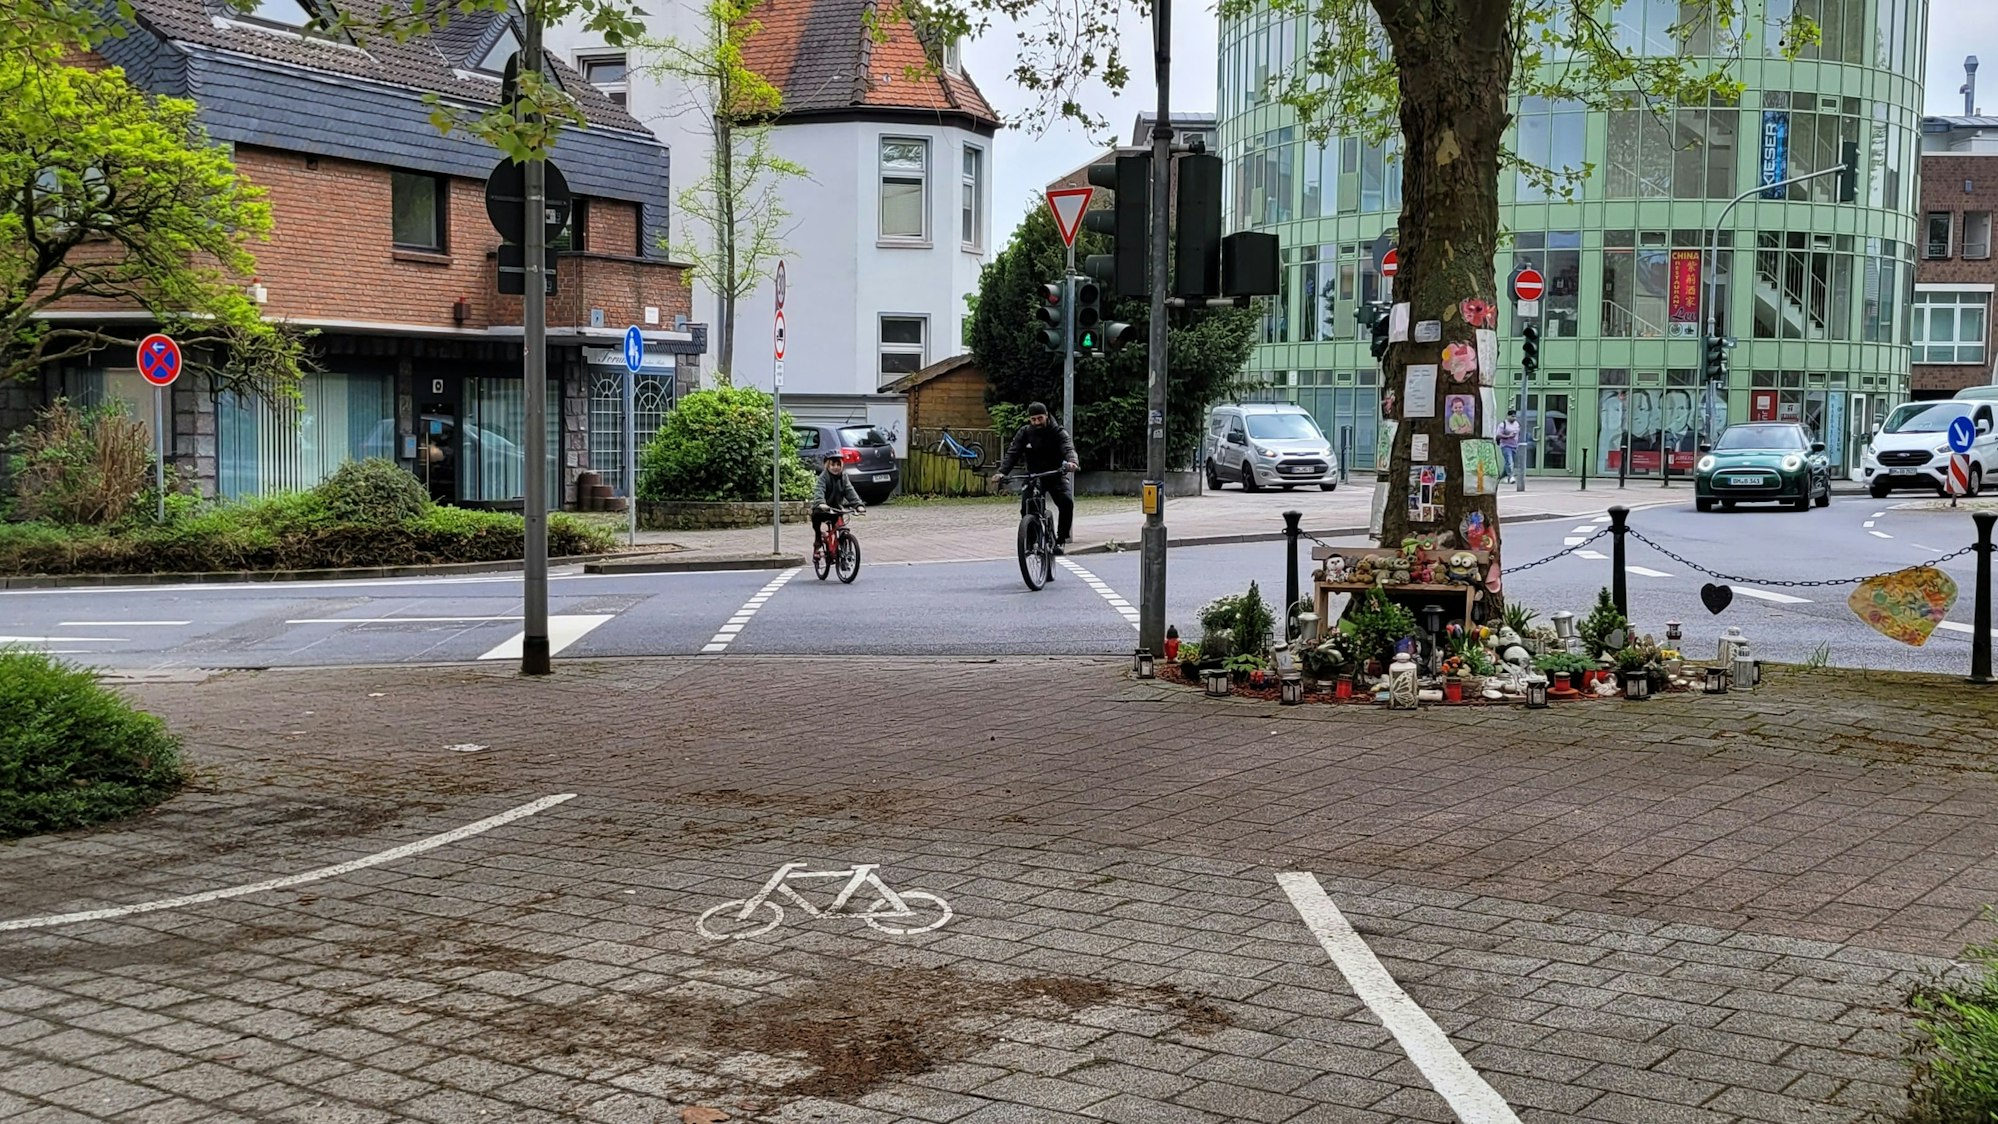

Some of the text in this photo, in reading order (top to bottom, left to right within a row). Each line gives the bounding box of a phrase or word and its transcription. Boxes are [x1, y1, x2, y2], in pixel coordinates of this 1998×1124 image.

[1763, 123, 1777, 186] KIESER
[1671, 251, 1700, 261] CHINA
[1672, 260, 1681, 310] RESTAURANT
